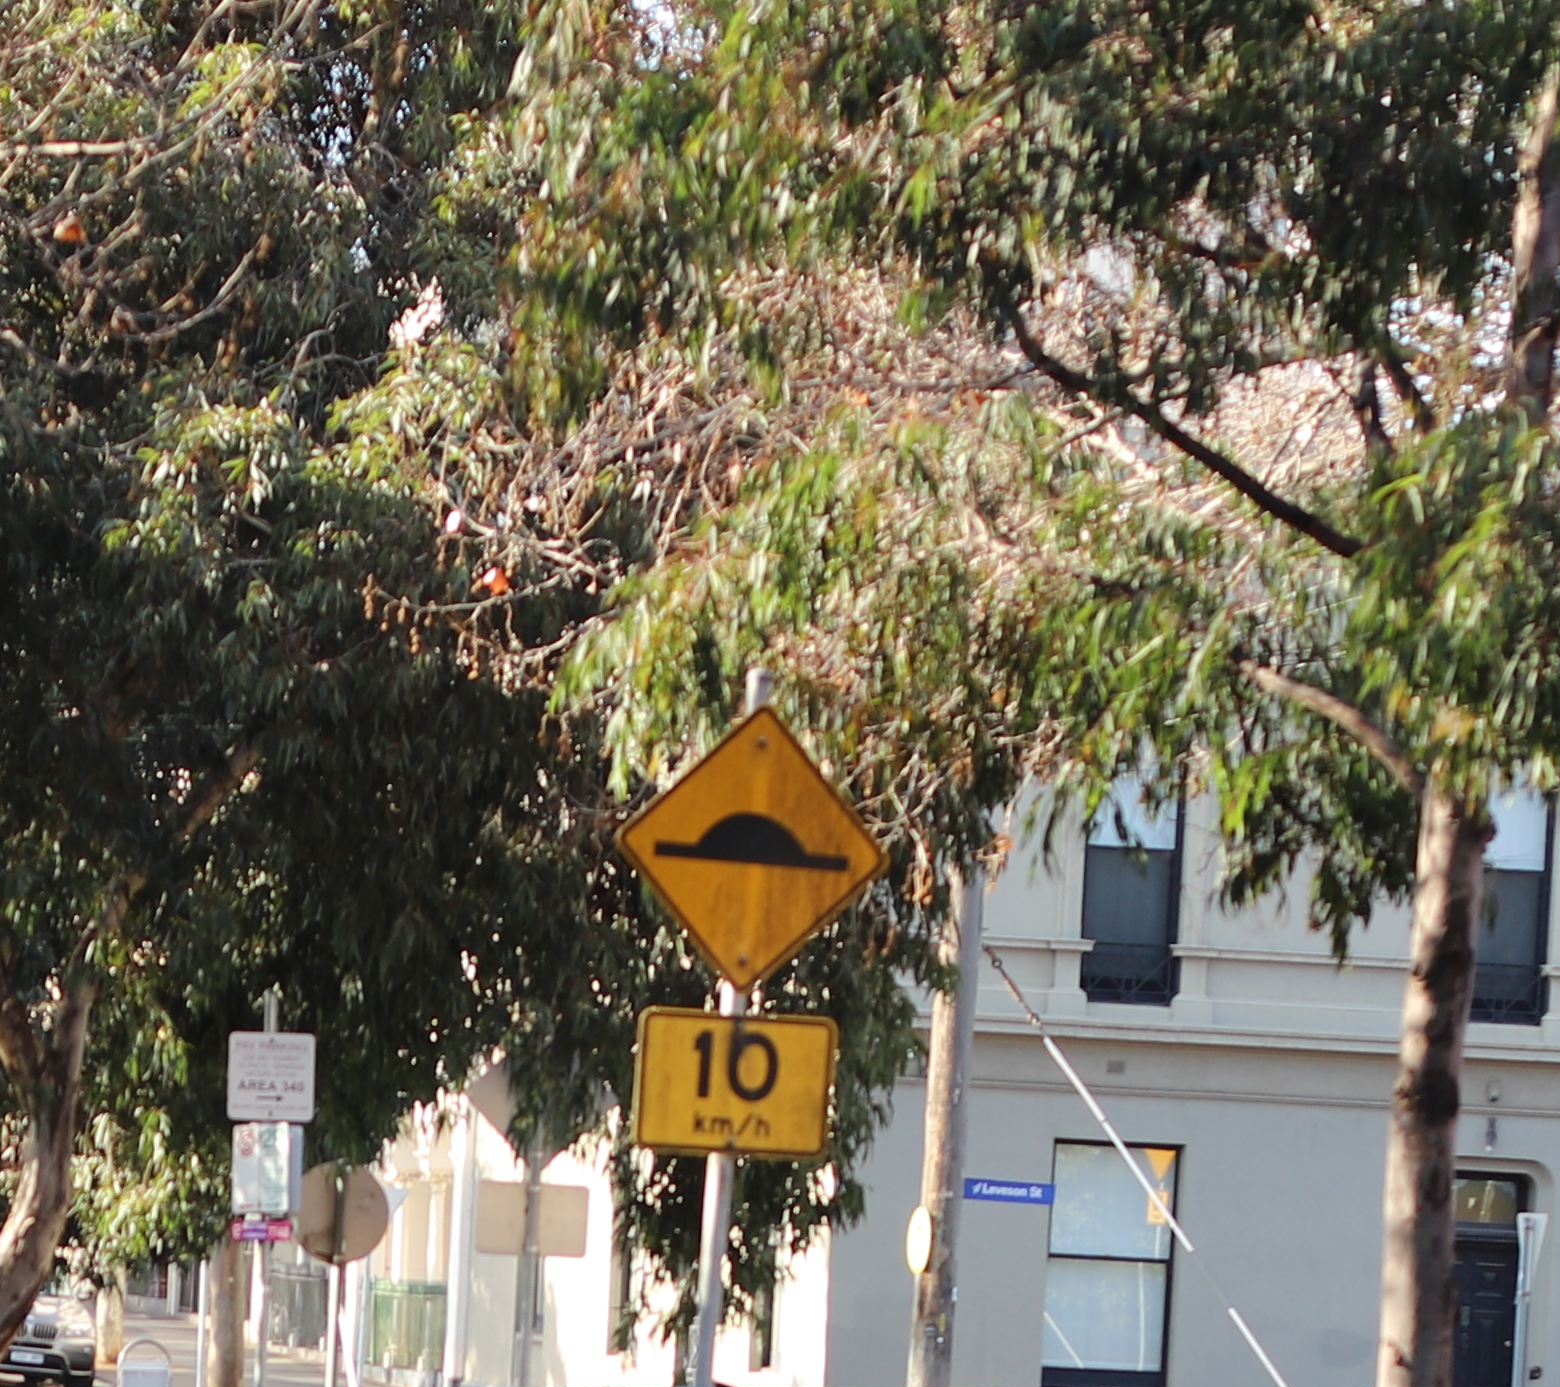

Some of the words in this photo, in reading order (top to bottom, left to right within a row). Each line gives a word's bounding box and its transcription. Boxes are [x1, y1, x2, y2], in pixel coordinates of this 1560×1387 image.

[694, 1031, 779, 1104] 10
[237, 1079, 277, 1091] AREA
[693, 1112, 770, 1137] km/h
[982, 1182, 1028, 1198] Leveson
[1029, 1185, 1043, 1199] St
